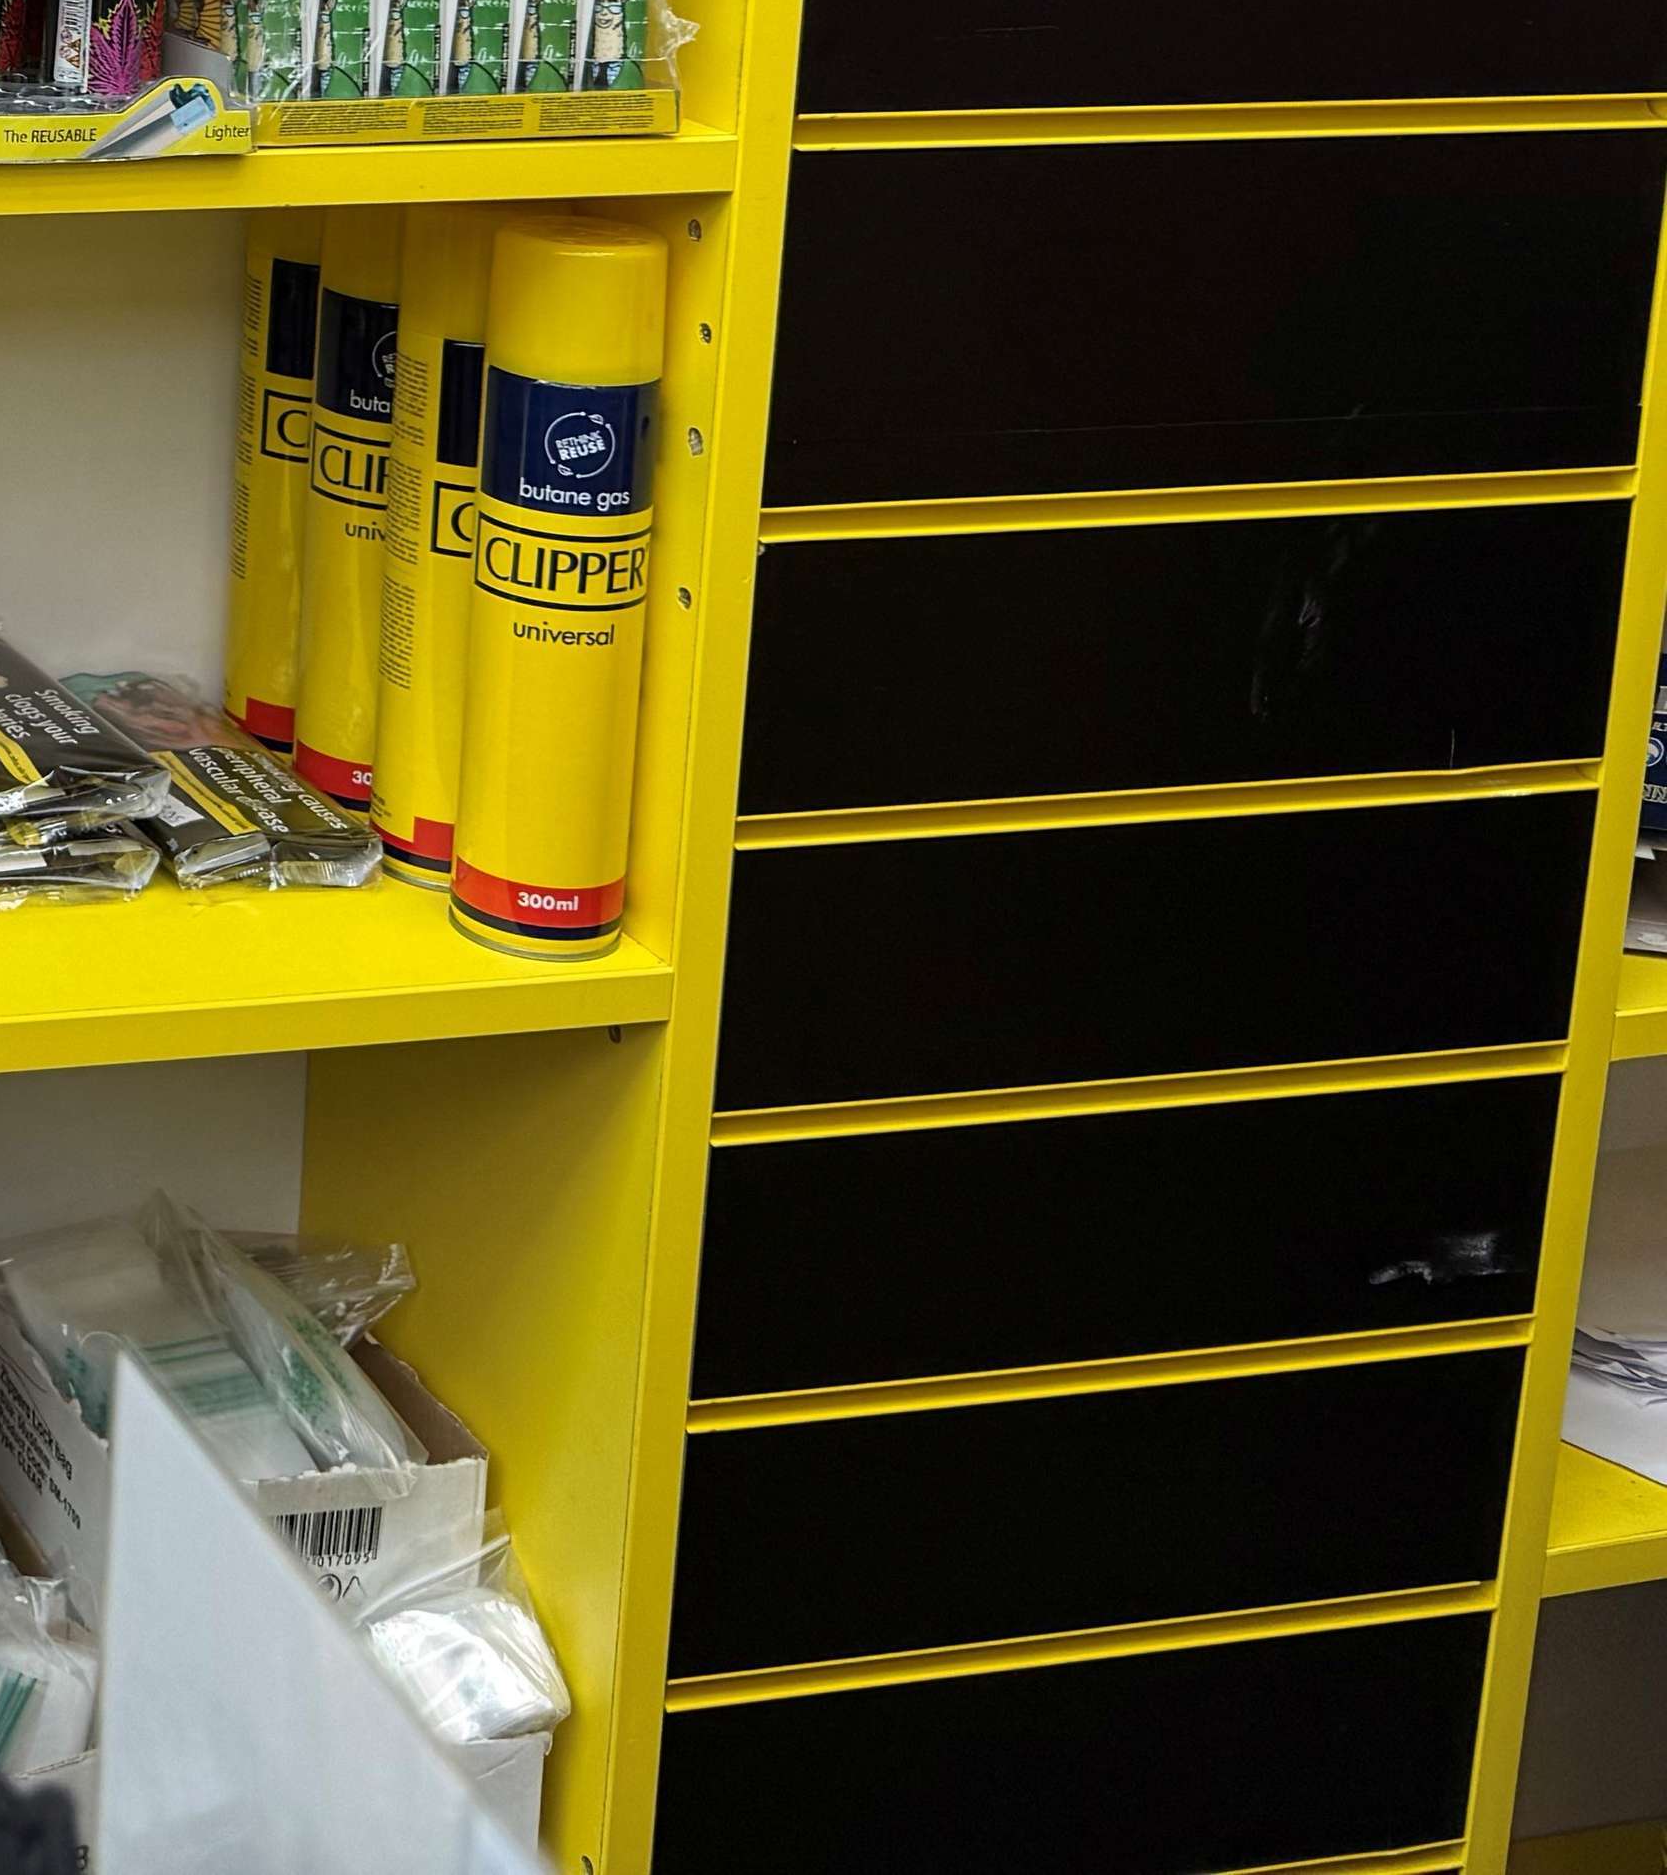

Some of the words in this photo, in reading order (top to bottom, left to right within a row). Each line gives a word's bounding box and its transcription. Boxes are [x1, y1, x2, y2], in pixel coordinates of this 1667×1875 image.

[519, 476, 591, 507] butane
[597, 484, 630, 513] gas
[485, 536, 646, 596] CLIPPER
[513, 621, 615, 647] universal
[517, 890, 578, 913] 300ml
